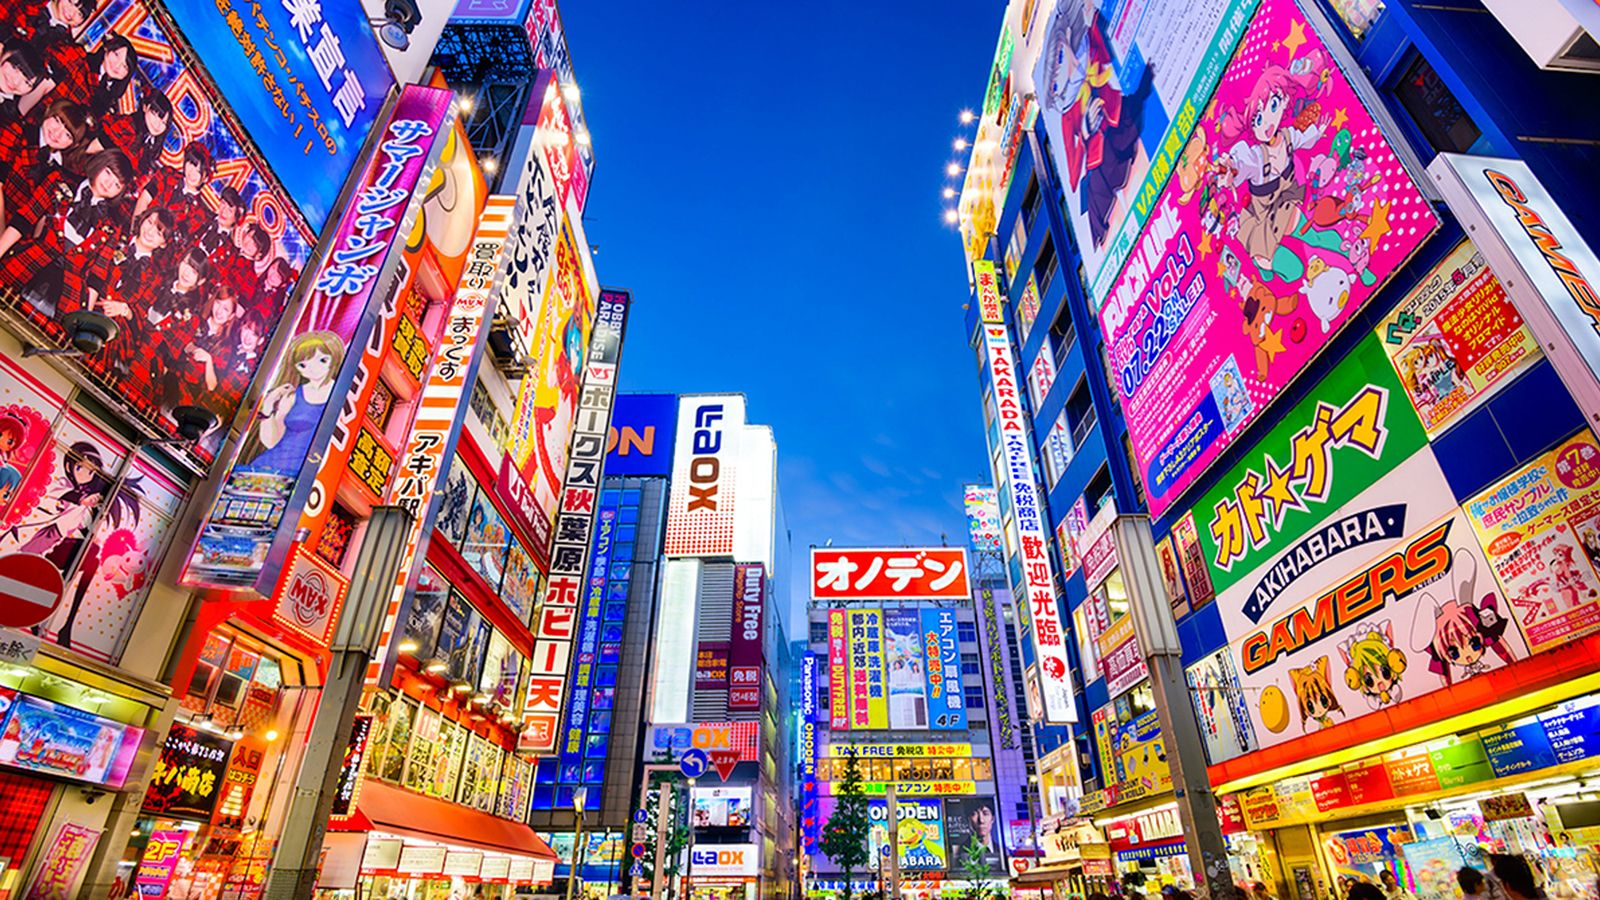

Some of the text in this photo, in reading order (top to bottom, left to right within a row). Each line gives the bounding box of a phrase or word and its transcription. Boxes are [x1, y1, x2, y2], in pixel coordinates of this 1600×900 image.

[316, 118, 433, 298] サマージャンボ
[467, 242, 500, 290] 買取り
[591, 293, 613, 361] PARADISE
[610, 294, 626, 338] HOBBY
[1463, 304, 1503, 342] オリジナル
[1122, 315, 1171, 397] 07.22
[1416, 360, 1457, 397] SAMPLE
[990, 345, 1021, 431] TAKARADA
[816, 551, 963, 592] オノデン
[1255, 509, 1386, 611] AKIHABARA
[743, 567, 763, 640] Duty Free
[1242, 517, 1455, 675] GAMERS
[804, 656, 814, 716] Panasonic
[233, 746, 262, 771] 入口
[804, 723, 814, 775] ONODEN
[862, 746, 894, 756] FREE
[1138, 808, 1181, 841] TAKARA
[144, 841, 178, 862] 2F
